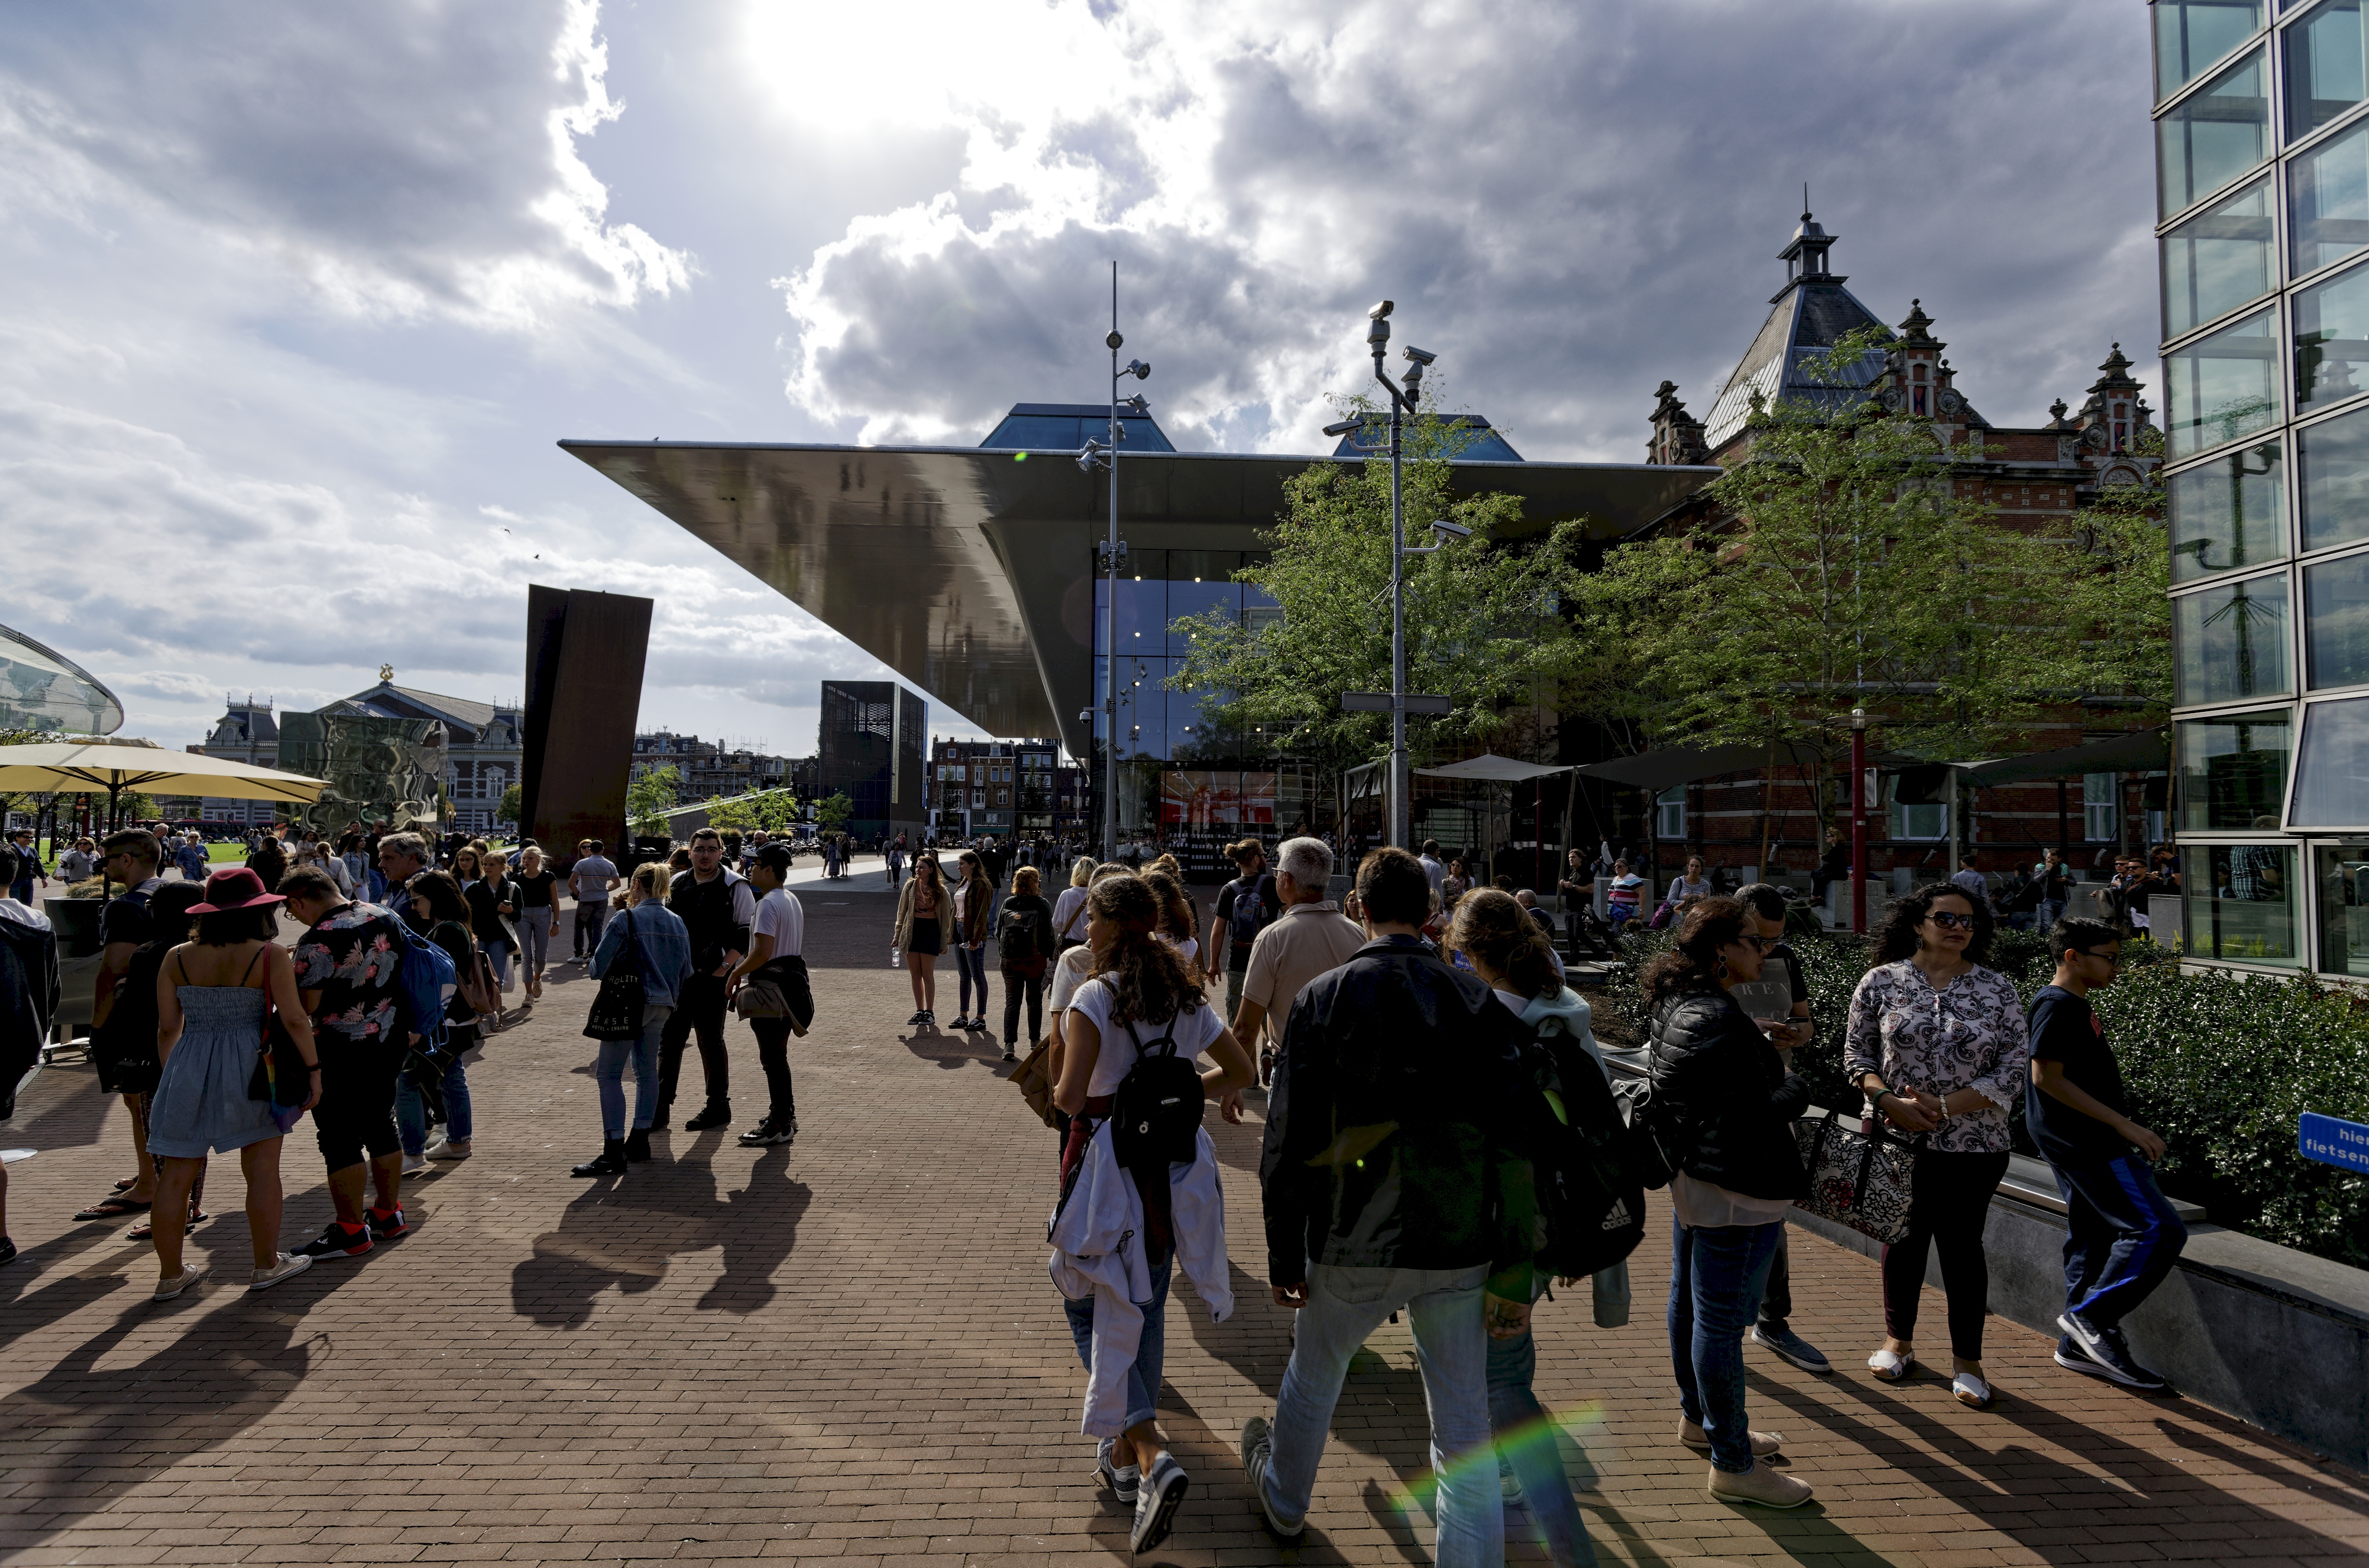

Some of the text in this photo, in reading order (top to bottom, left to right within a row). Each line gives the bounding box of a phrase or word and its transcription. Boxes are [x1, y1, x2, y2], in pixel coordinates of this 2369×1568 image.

[1116, 767, 1150, 786] EDELIJK
[593, 1015, 629, 1025] BASE
[2306, 1138, 2369, 1165] fietsen
[1879, 1179, 1910, 1204] COACH
[1601, 1214, 1632, 1230] adidas
